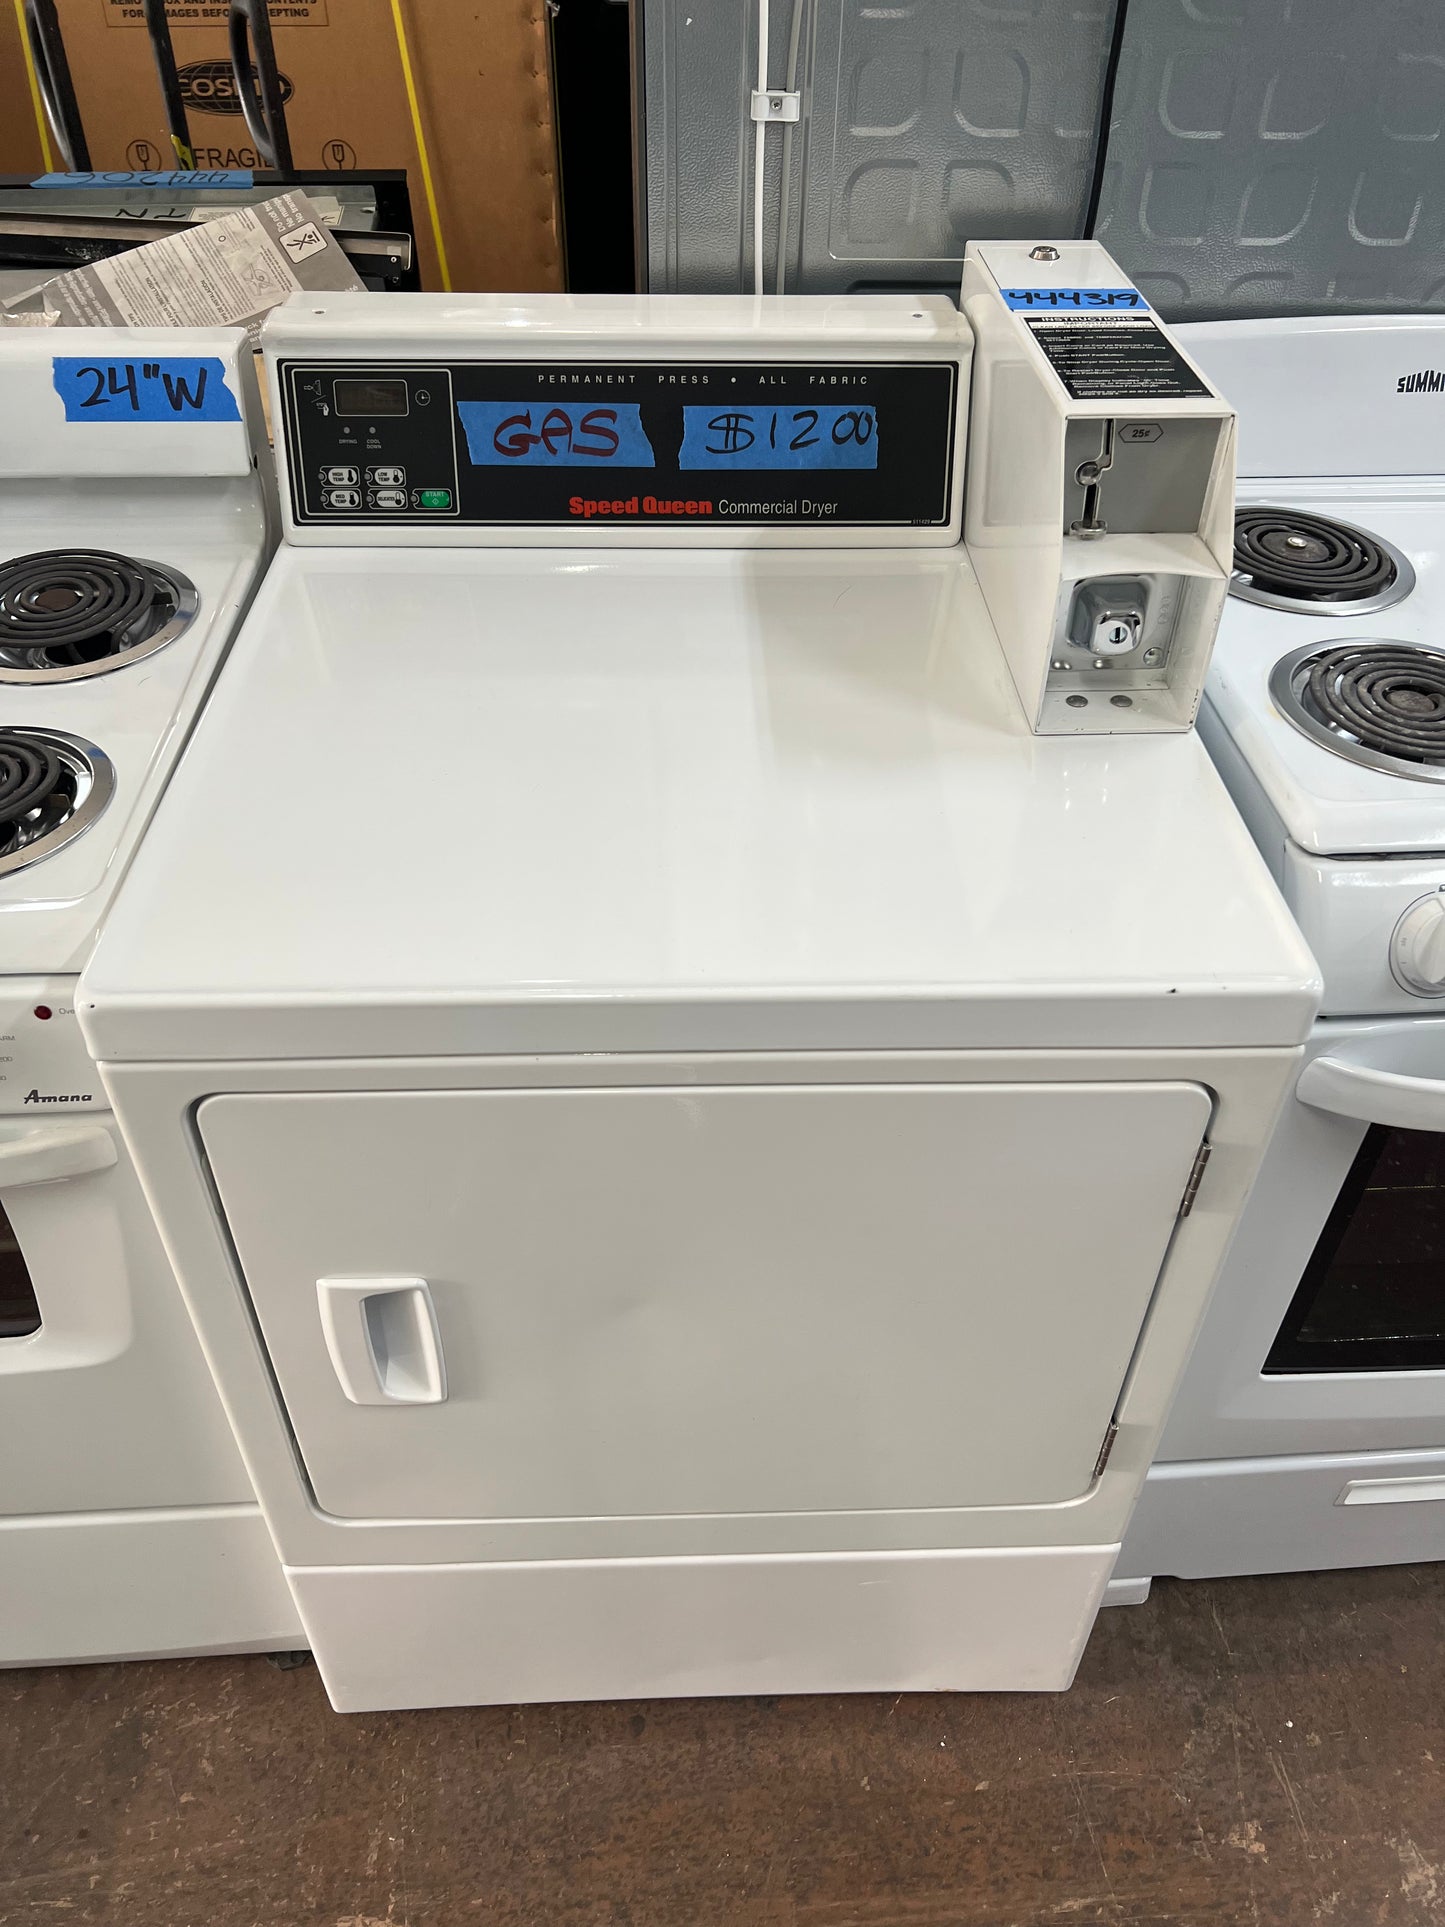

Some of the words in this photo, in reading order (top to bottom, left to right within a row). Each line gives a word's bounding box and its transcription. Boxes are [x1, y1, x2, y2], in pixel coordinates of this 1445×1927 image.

[122, 9, 145, 18] FOR
[202, 8, 230, 18] BEFO
[268, 8, 309, 17] EPTING
[1008, 291, 1139, 307] 444319
[537, 374, 638, 385] PERMANENT
[658, 375, 710, 385] PRESS
[758, 376, 788, 386] ALL
[809, 376, 870, 386] FABRIC
[1396, 369, 1445, 393] SUMMI
[492, 407, 620, 457] GAS
[568, 496, 640, 518] Speed
[642, 496, 713, 515] Queen
[717, 498, 798, 515] Commercial
[801, 499, 839, 517] Dryer
[58, 1007, 76, 1015] Ove
[24, 1089, 93, 1104] Amana
